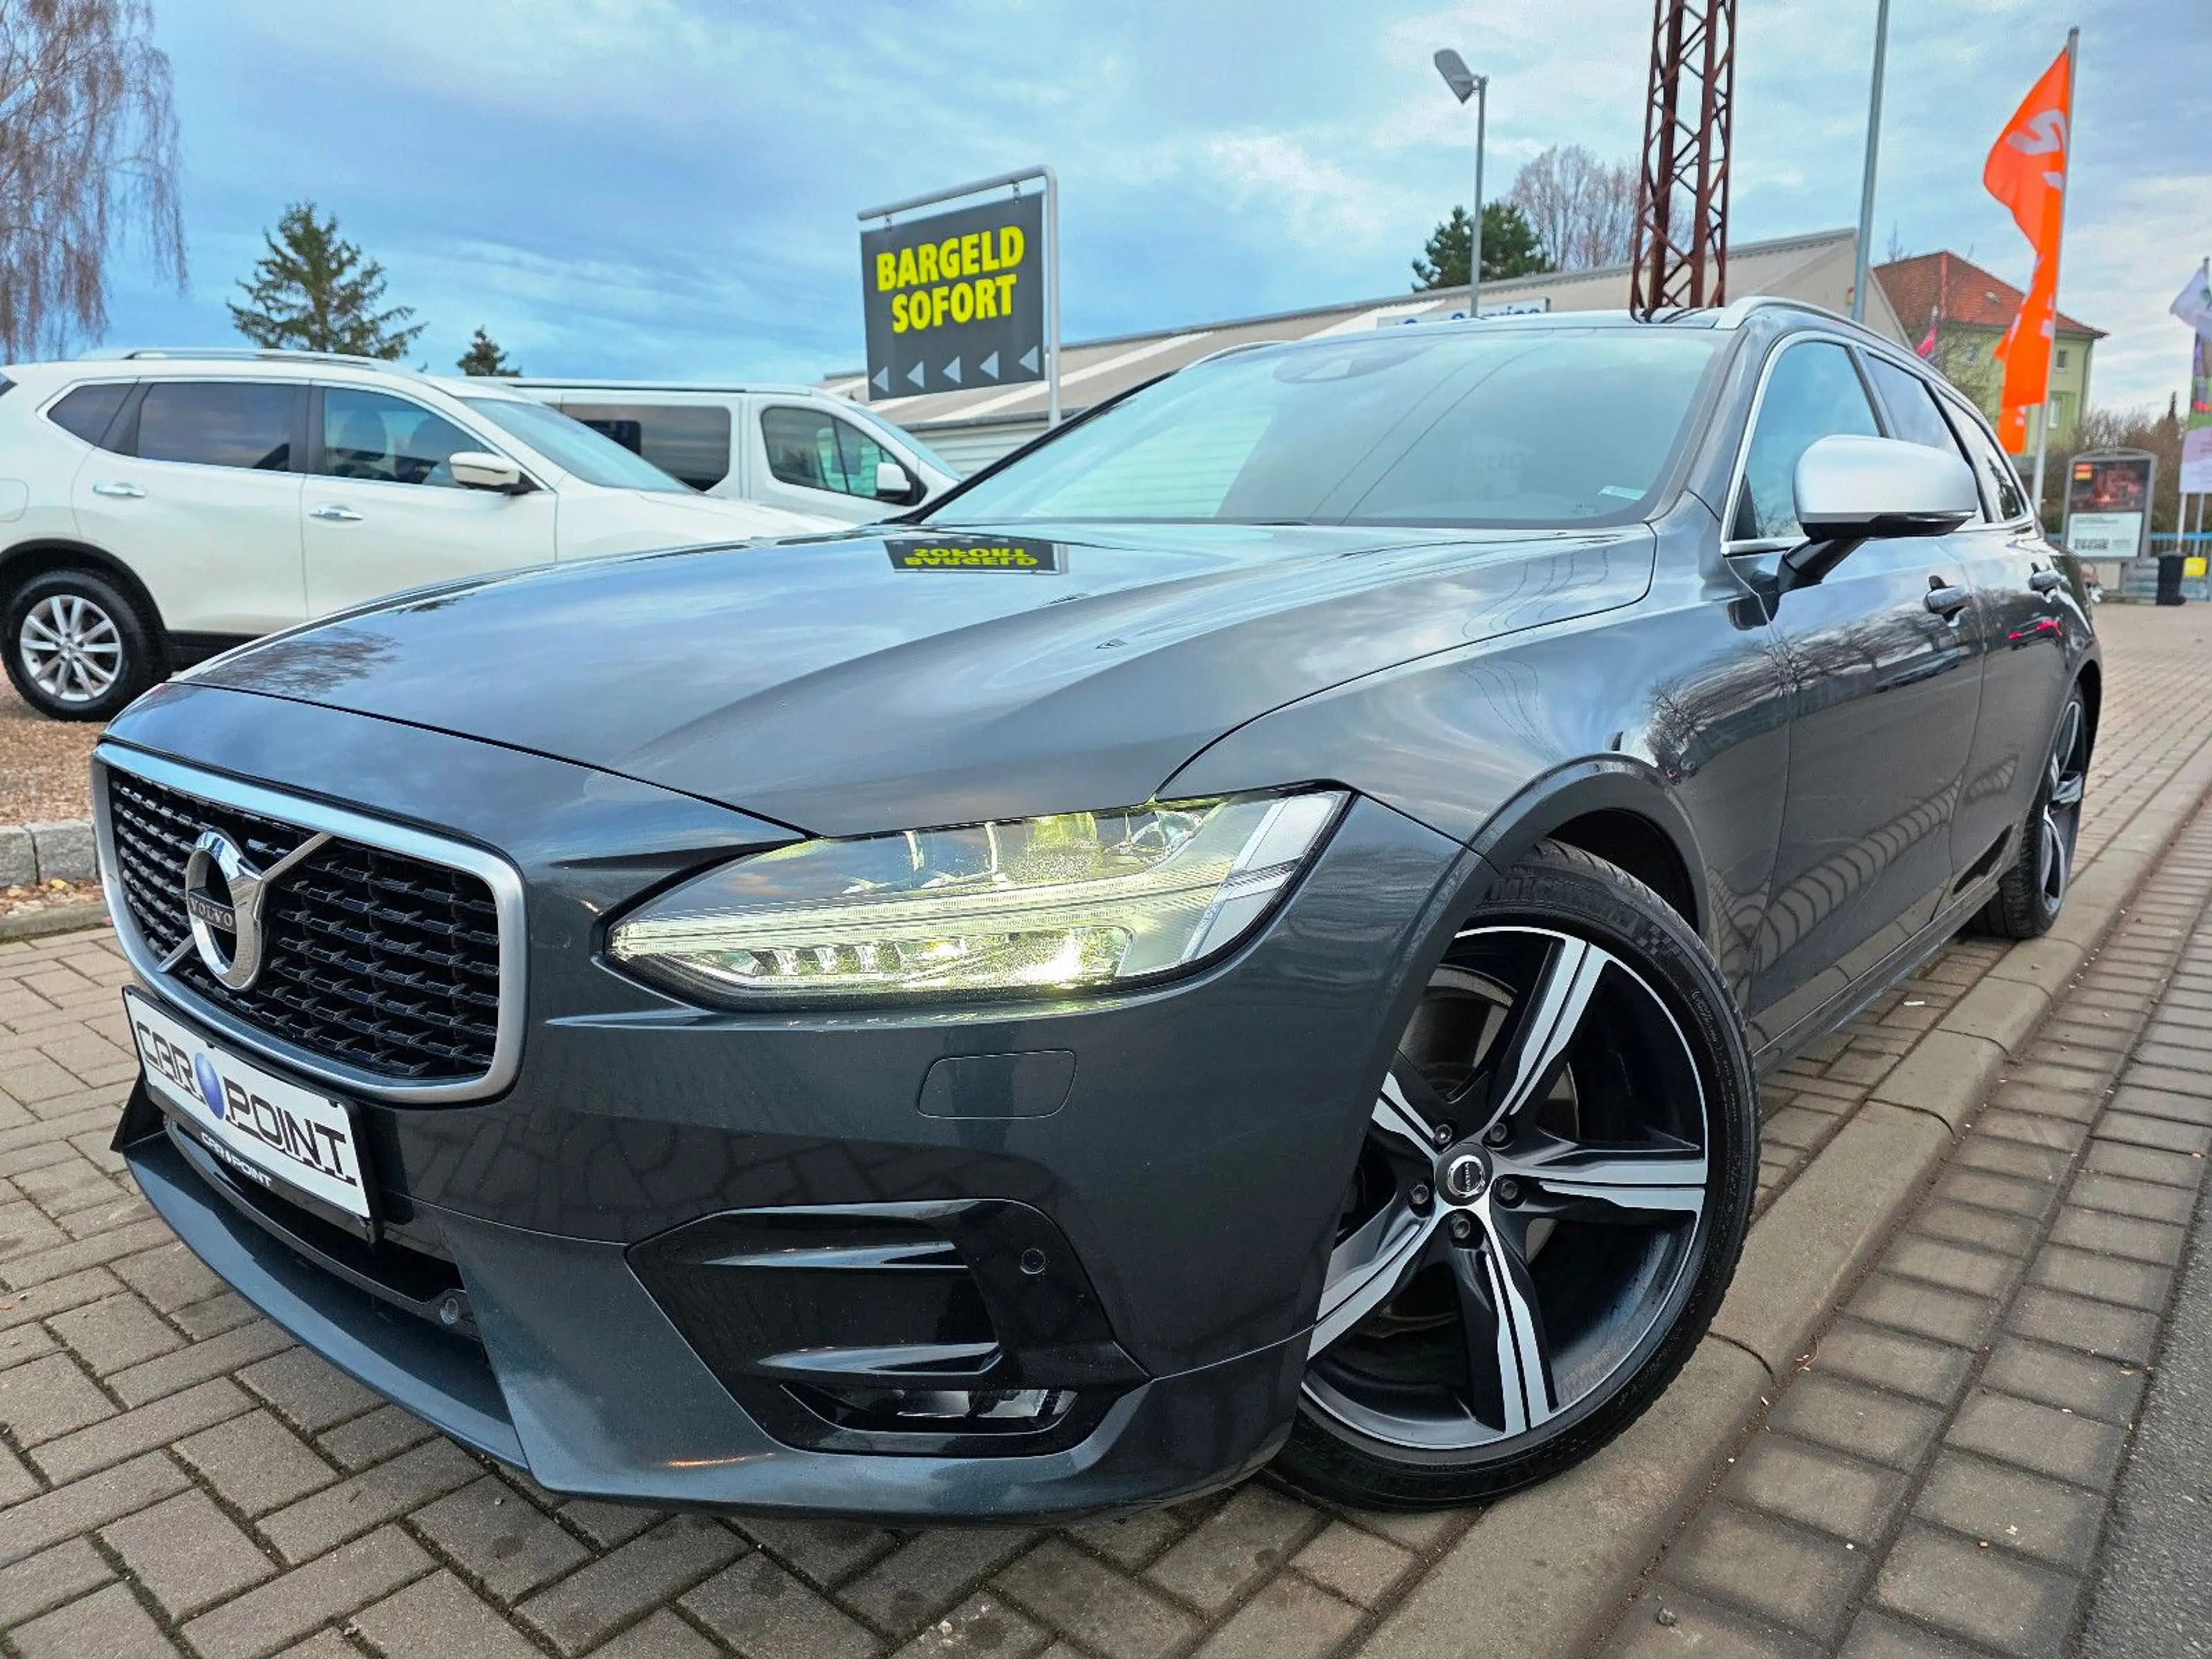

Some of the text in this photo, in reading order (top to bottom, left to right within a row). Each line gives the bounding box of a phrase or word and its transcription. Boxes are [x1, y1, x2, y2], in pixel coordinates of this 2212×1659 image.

[876, 226, 1025, 292] BARGELD
[891, 274, 1017, 334] SOFORT
[191, 900, 233, 927] VOLVO
[137, 1020, 347, 1177] CAR POINT
[231, 1154, 272, 1187] POINT
